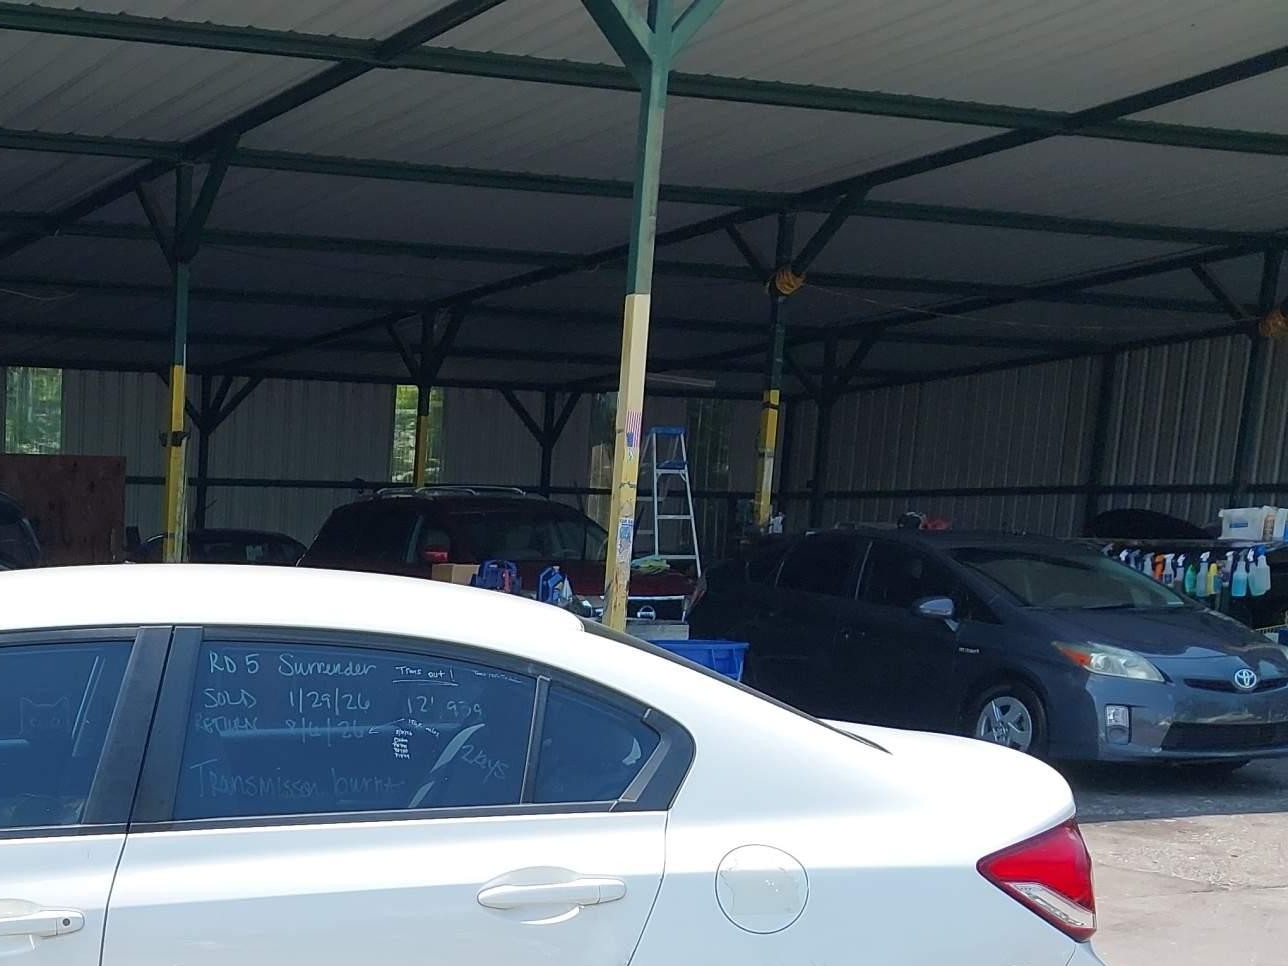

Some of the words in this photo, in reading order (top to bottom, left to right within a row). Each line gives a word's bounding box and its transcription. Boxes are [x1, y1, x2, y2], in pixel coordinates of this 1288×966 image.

[210, 651, 237, 673] RD
[245, 653, 260, 674] 5
[204, 687, 257, 709] SOLD
[289, 687, 371, 715] 1/29/26
